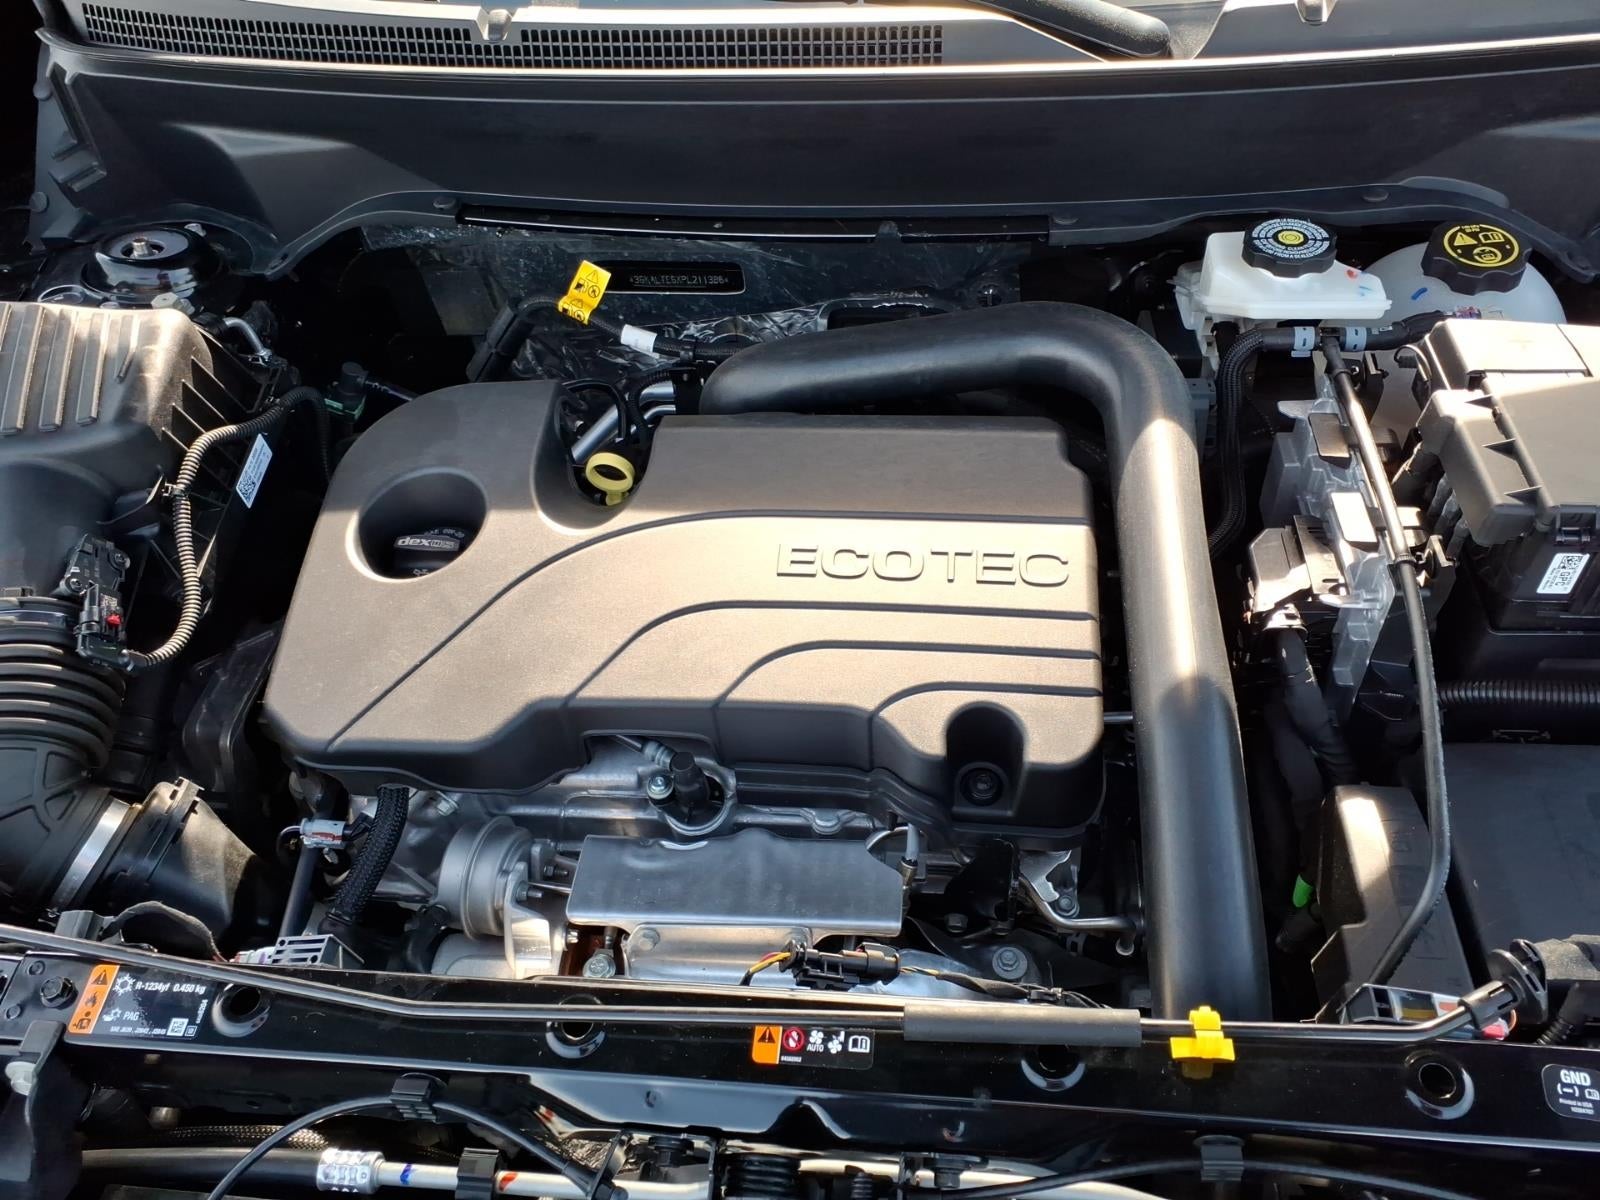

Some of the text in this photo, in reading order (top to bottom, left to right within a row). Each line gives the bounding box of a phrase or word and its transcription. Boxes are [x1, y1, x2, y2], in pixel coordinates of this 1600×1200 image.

[776, 543, 1070, 587] ECOTEC
[135, 982, 207, 995] R-1234yf 0.450 kg
[123, 1011, 139, 1021] PAG
[806, 1044, 825, 1052] AUTO
[1560, 1068, 1591, 1086] GND
